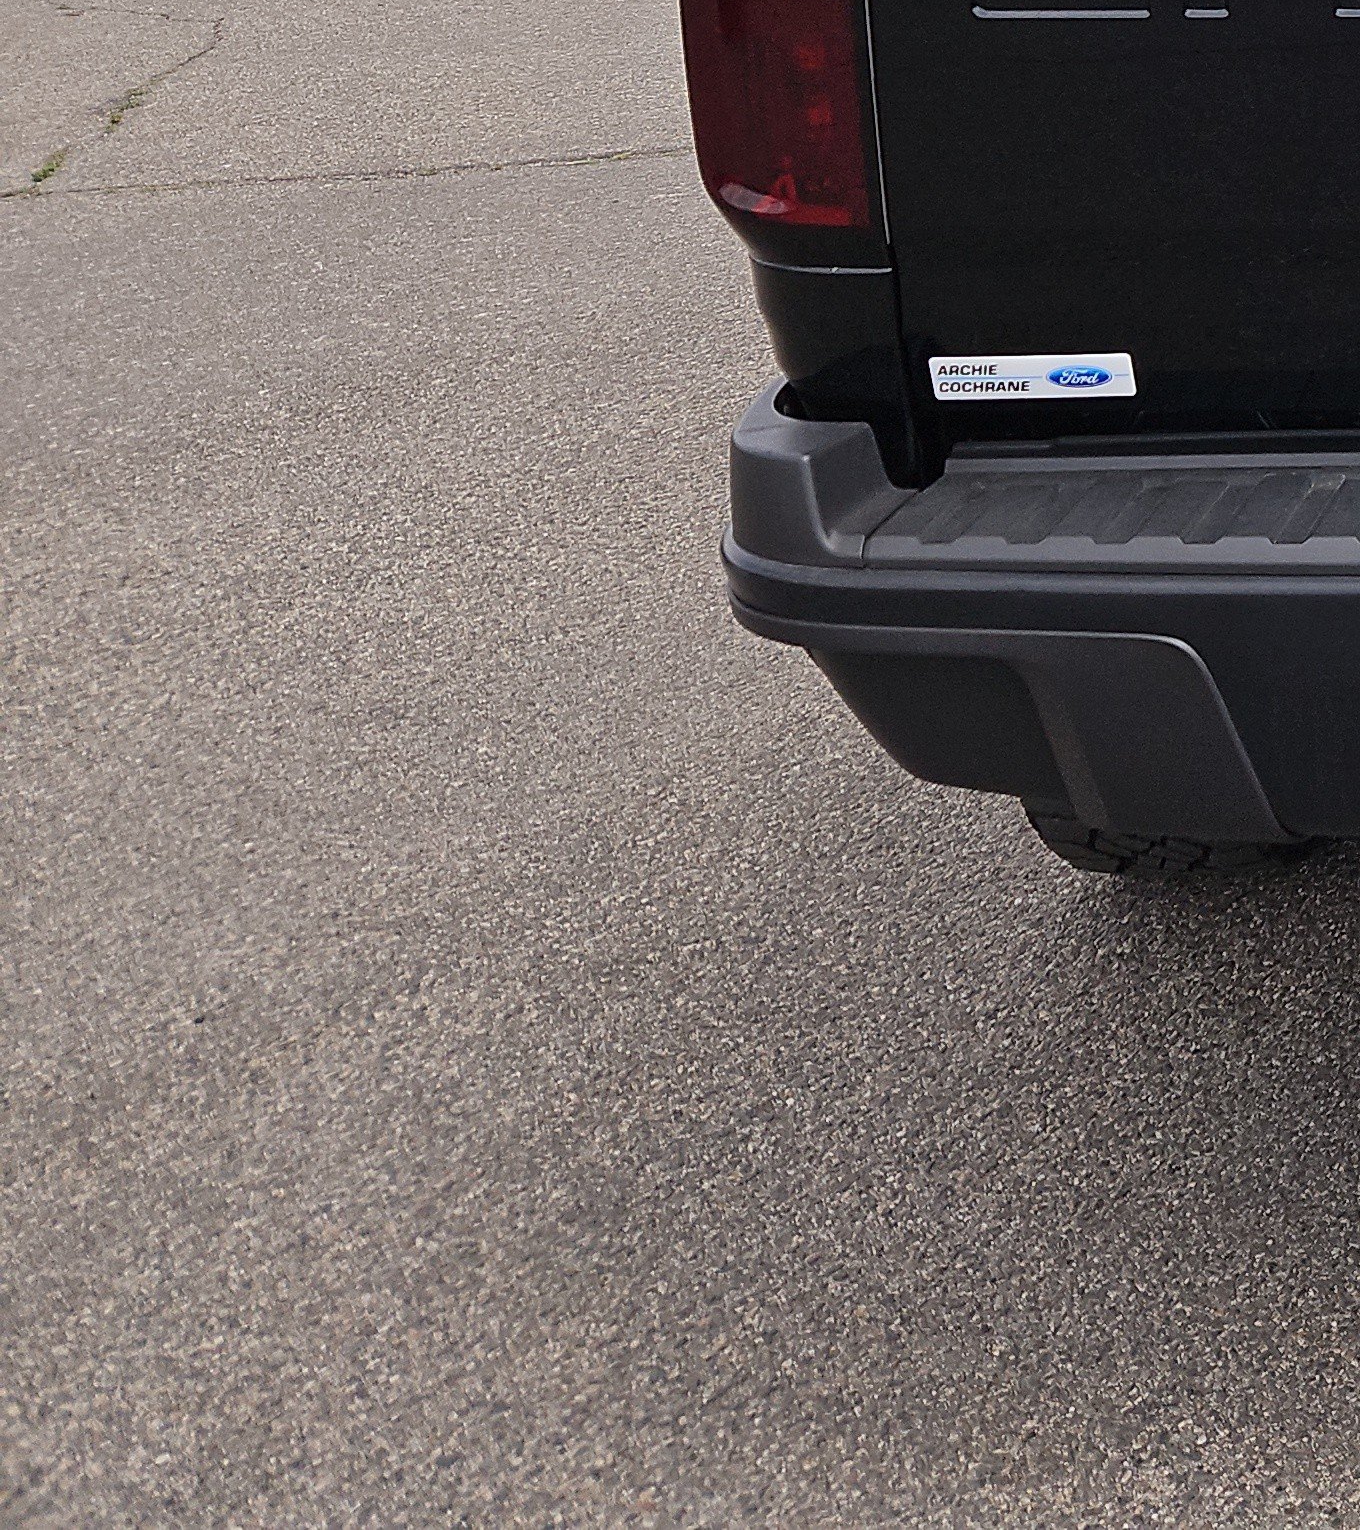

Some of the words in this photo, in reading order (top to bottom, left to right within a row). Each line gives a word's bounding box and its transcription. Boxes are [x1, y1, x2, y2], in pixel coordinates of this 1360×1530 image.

[937, 364, 997, 376] ARCHIE
[1057, 368, 1100, 385] Ford
[939, 380, 1030, 393] COCHRANE
